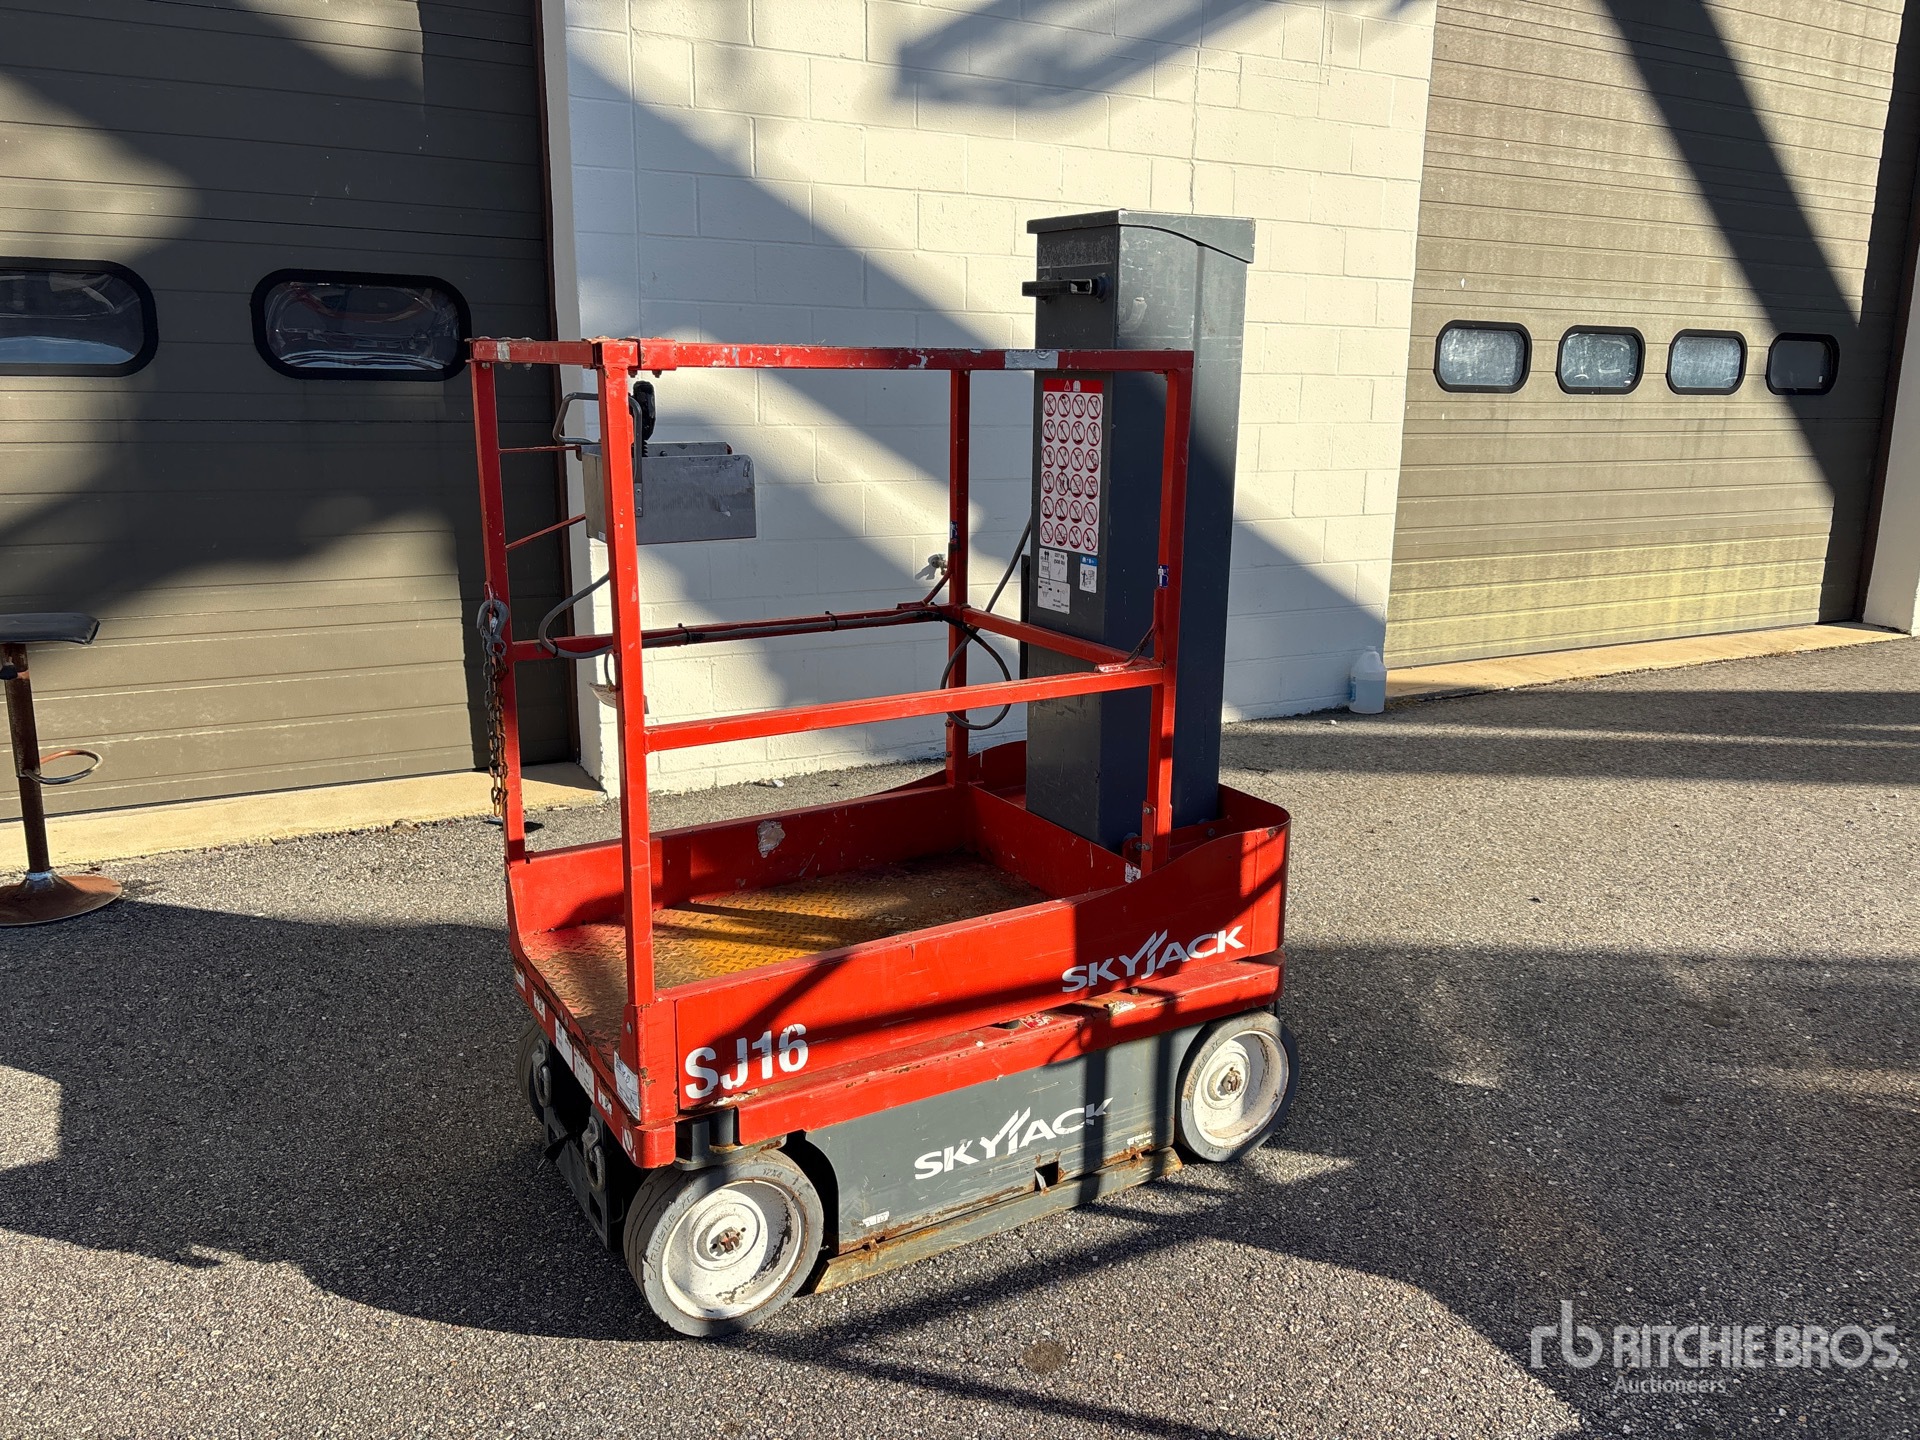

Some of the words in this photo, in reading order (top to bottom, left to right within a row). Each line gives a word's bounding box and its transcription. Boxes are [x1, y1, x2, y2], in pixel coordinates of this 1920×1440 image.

[1061, 925, 1246, 993] SKYJACK
[684, 1023, 809, 1099] SJ16
[914, 1097, 1114, 1180] SKYJACK
